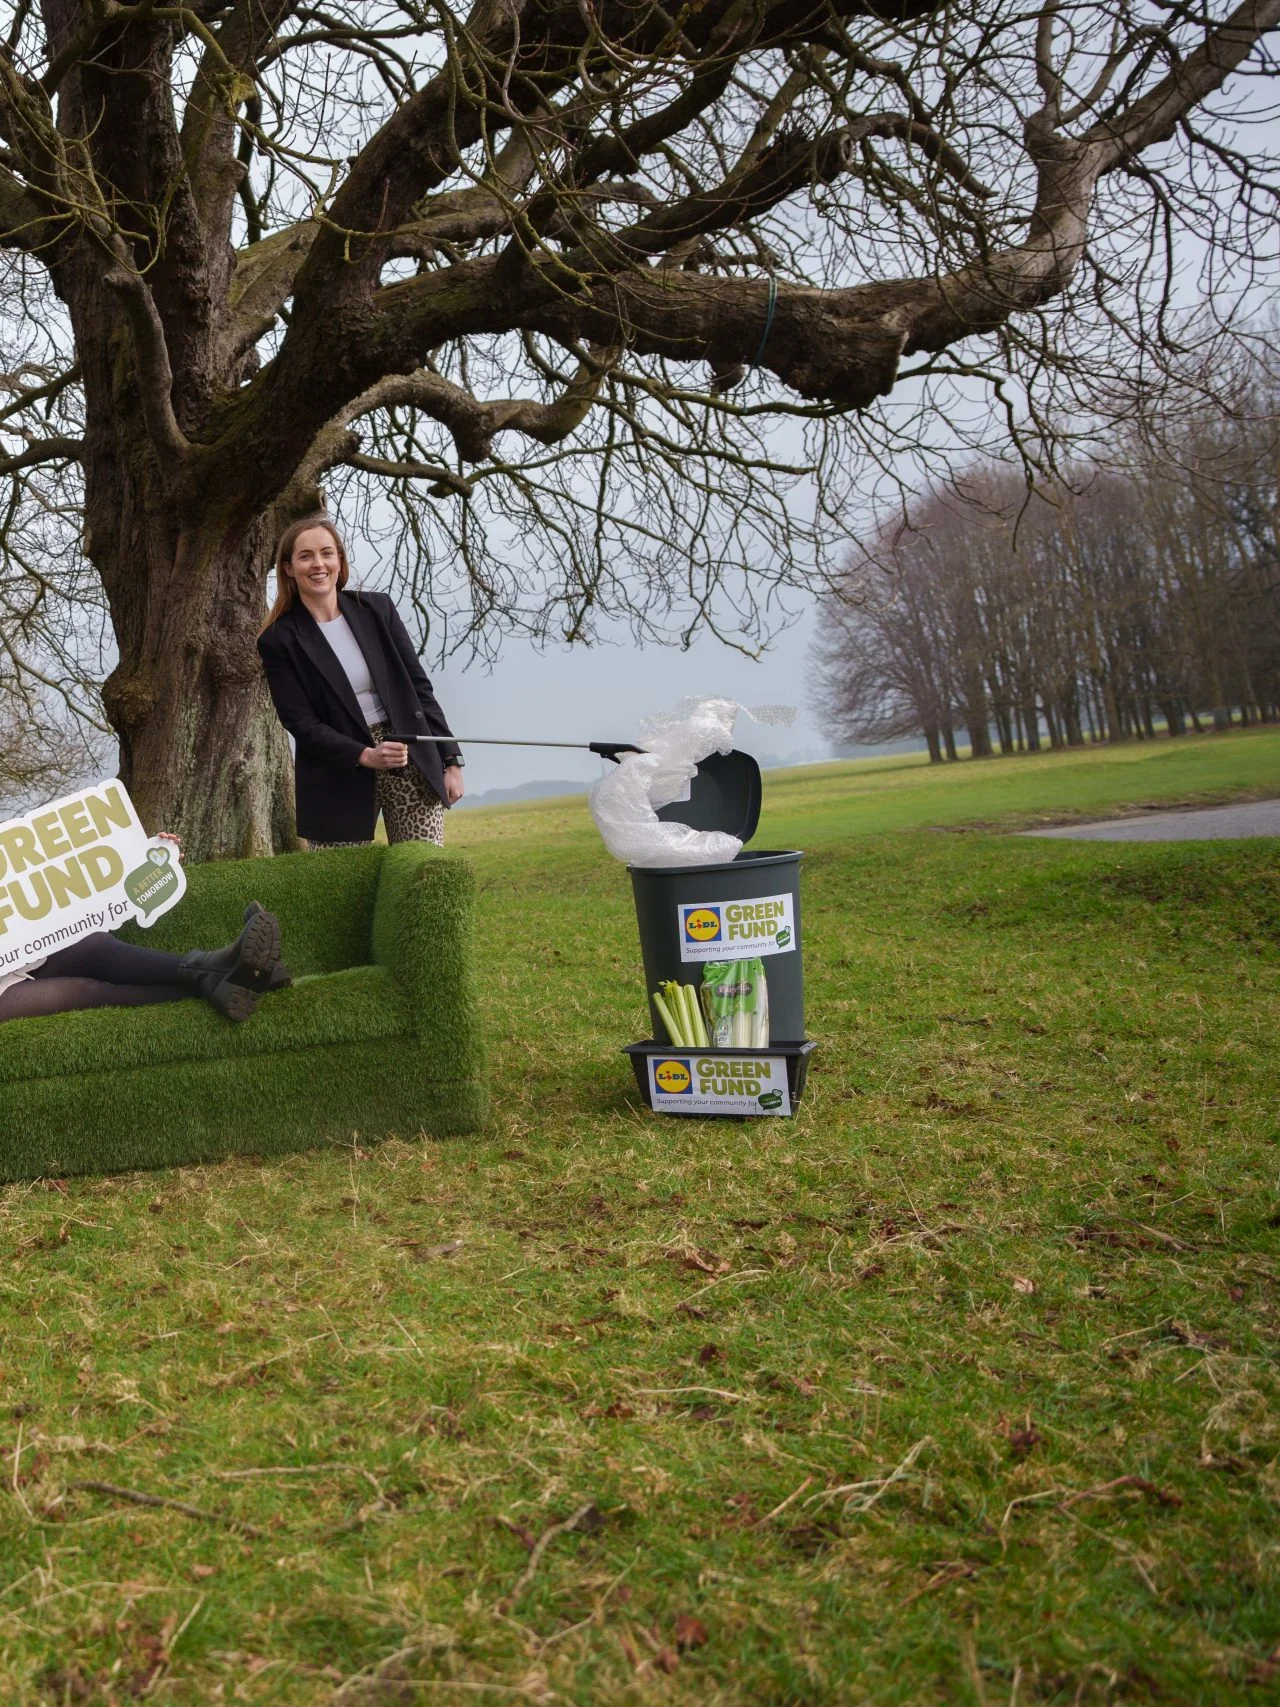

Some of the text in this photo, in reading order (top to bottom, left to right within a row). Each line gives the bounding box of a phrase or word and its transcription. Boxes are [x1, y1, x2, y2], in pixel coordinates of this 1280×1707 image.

[132, 868, 163, 896] A BETTER
[136, 871, 174, 905] TOMORROW
[725, 900, 785, 923] GREEN
[24, 910, 104, 955] community
[107, 900, 128, 921] for
[728, 919, 778, 941] FUND
[686, 946, 721, 954] Supporting
[736, 941, 767, 951] community
[696, 1058, 772, 1079] GREEN
[700, 1078, 762, 1097] FUND
[656, 1098, 692, 1106] Supporting
